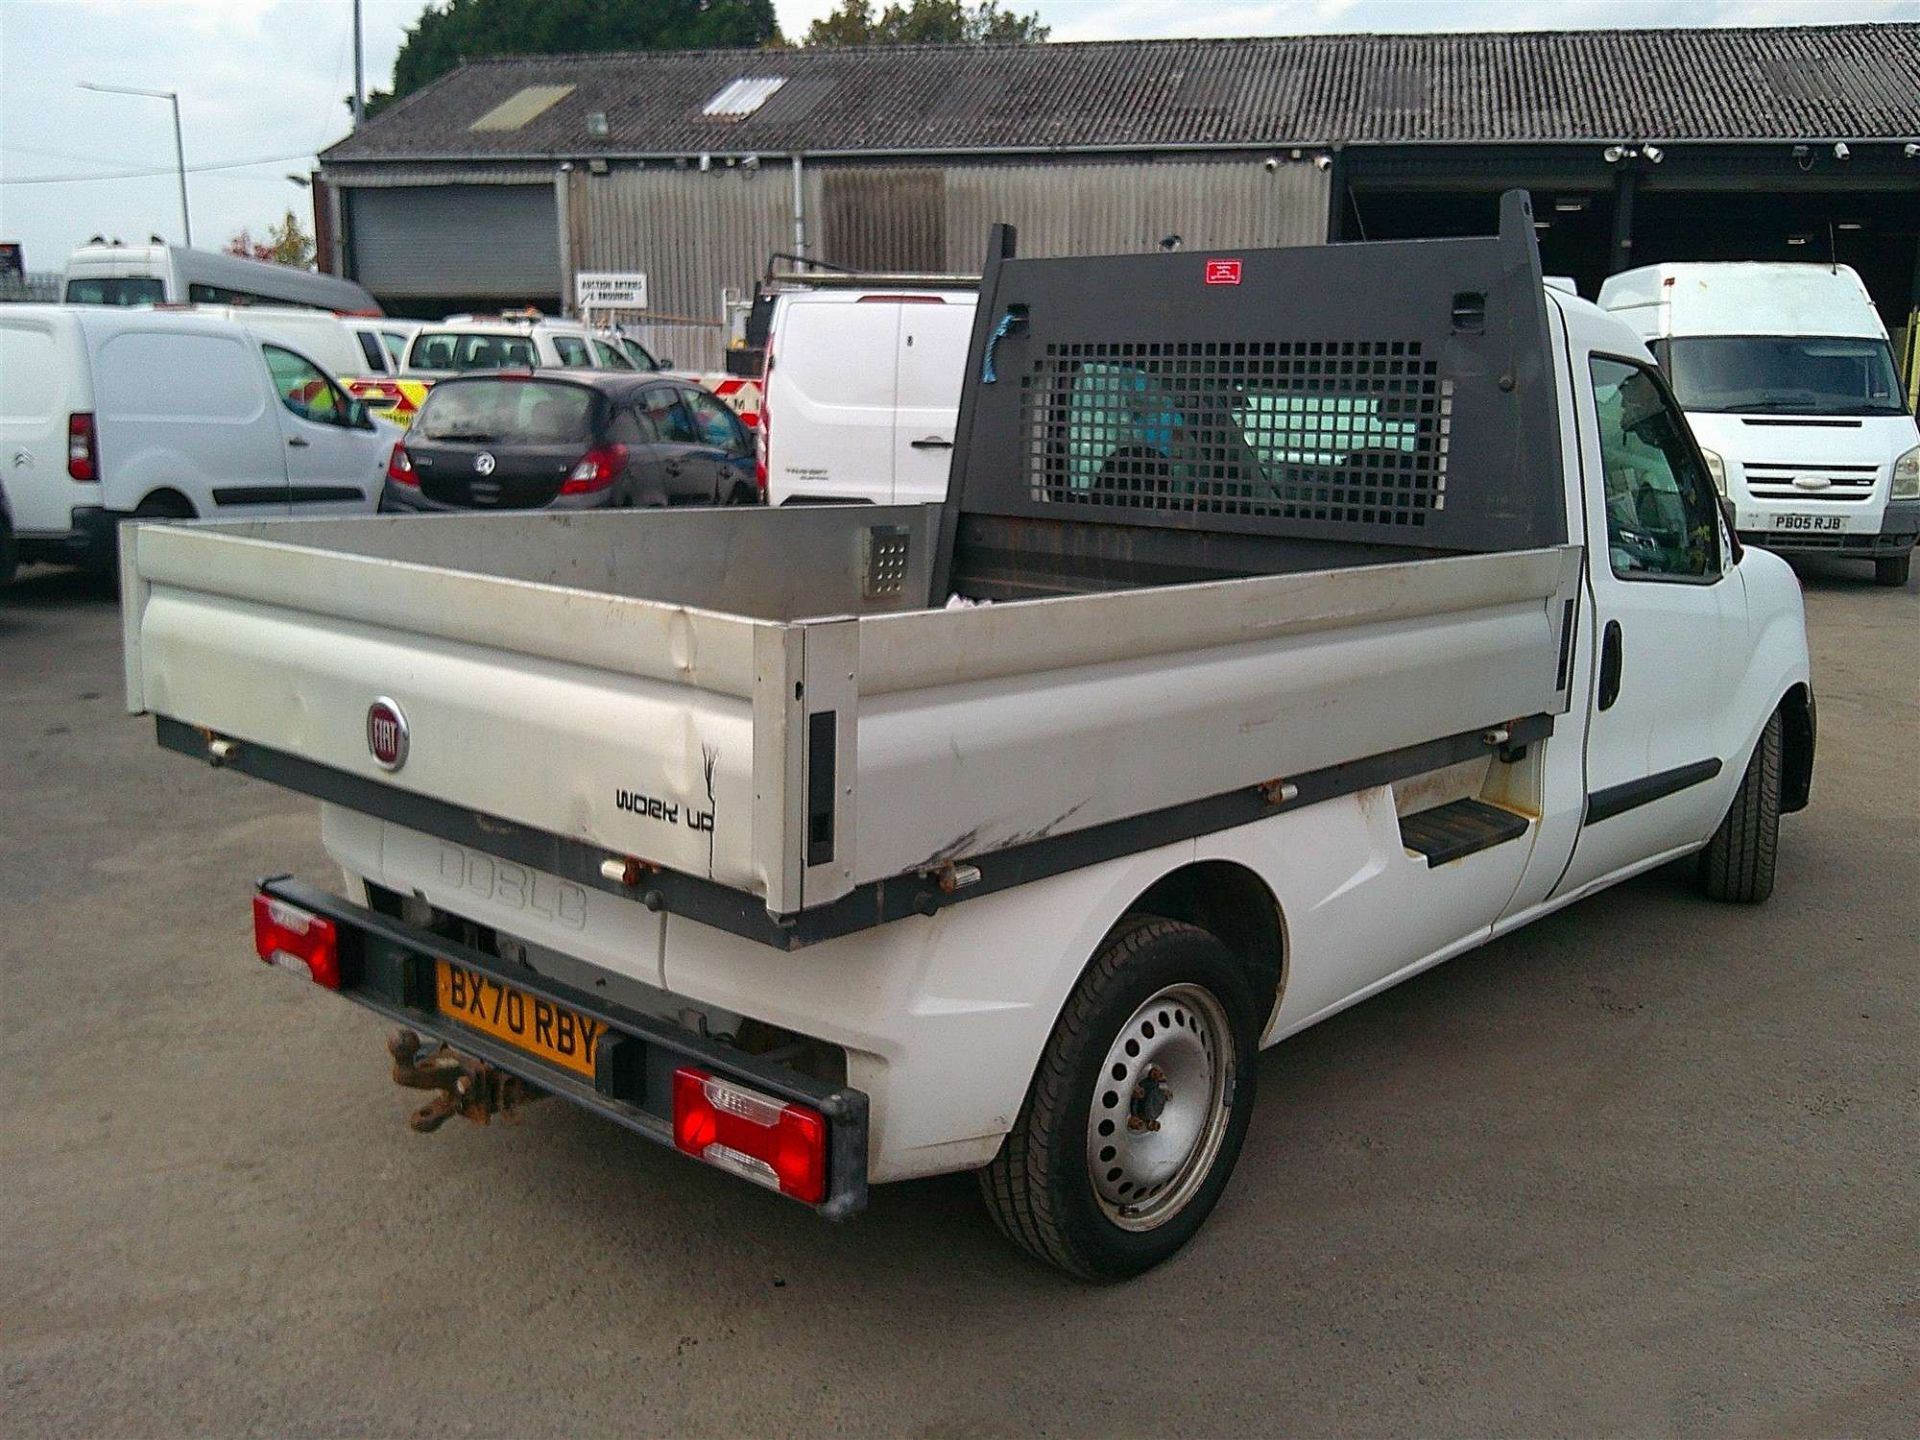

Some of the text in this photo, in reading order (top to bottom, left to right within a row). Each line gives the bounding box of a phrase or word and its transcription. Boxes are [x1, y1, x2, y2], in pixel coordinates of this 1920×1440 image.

[1775, 515, 1841, 530] PB05 RJB
[374, 718, 398, 755] FIAT
[616, 789, 715, 832] WORK UP
[451, 965, 598, 1065] BX70 RBY
